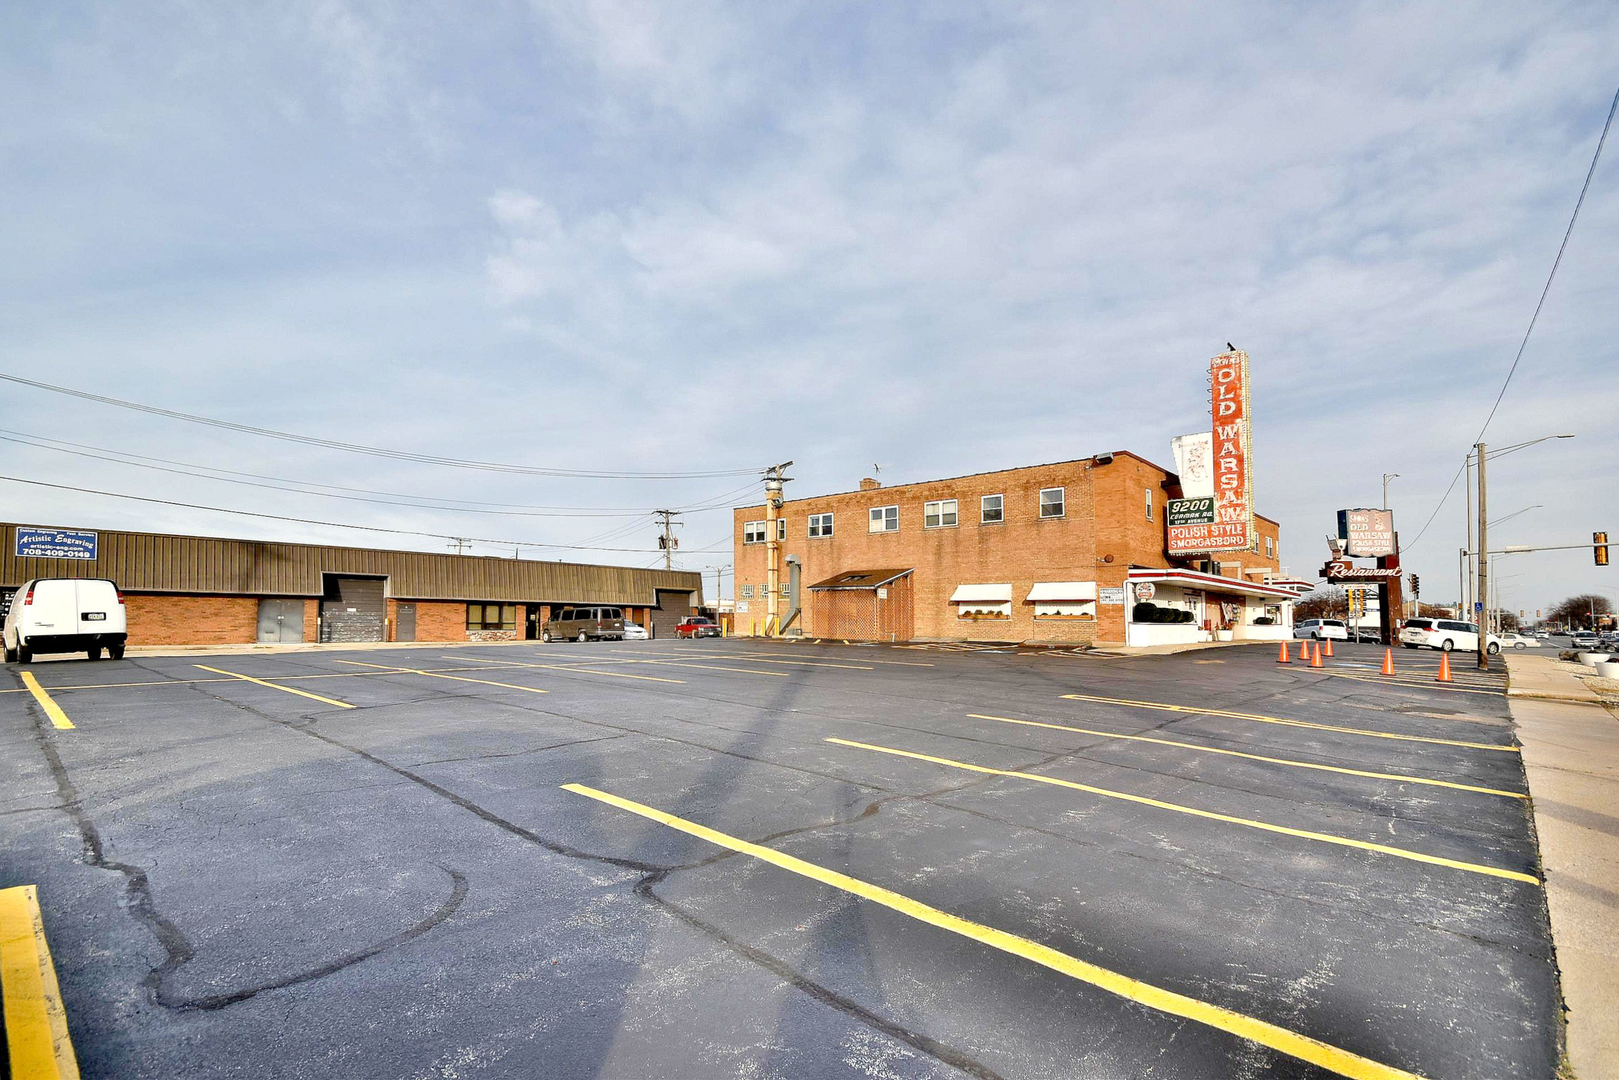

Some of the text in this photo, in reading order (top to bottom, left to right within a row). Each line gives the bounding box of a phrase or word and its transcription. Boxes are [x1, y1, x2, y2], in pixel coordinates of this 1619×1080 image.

[1218, 367, 1236, 416] OLD
[1216, 425, 1242, 521] WARSAW
[1171, 500, 1210, 513] 9200
[1171, 524, 1243, 538] POLISH STYLE
[1350, 523, 1369, 531] OLD
[19, 534, 94, 549] Artistic Engraving
[1350, 531, 1391, 539] WARSAW
[1171, 536, 1244, 548] SMORGASBORD
[22, 548, 91, 558] 708-409-0149
[1329, 562, 1403, 578] Restaurant
